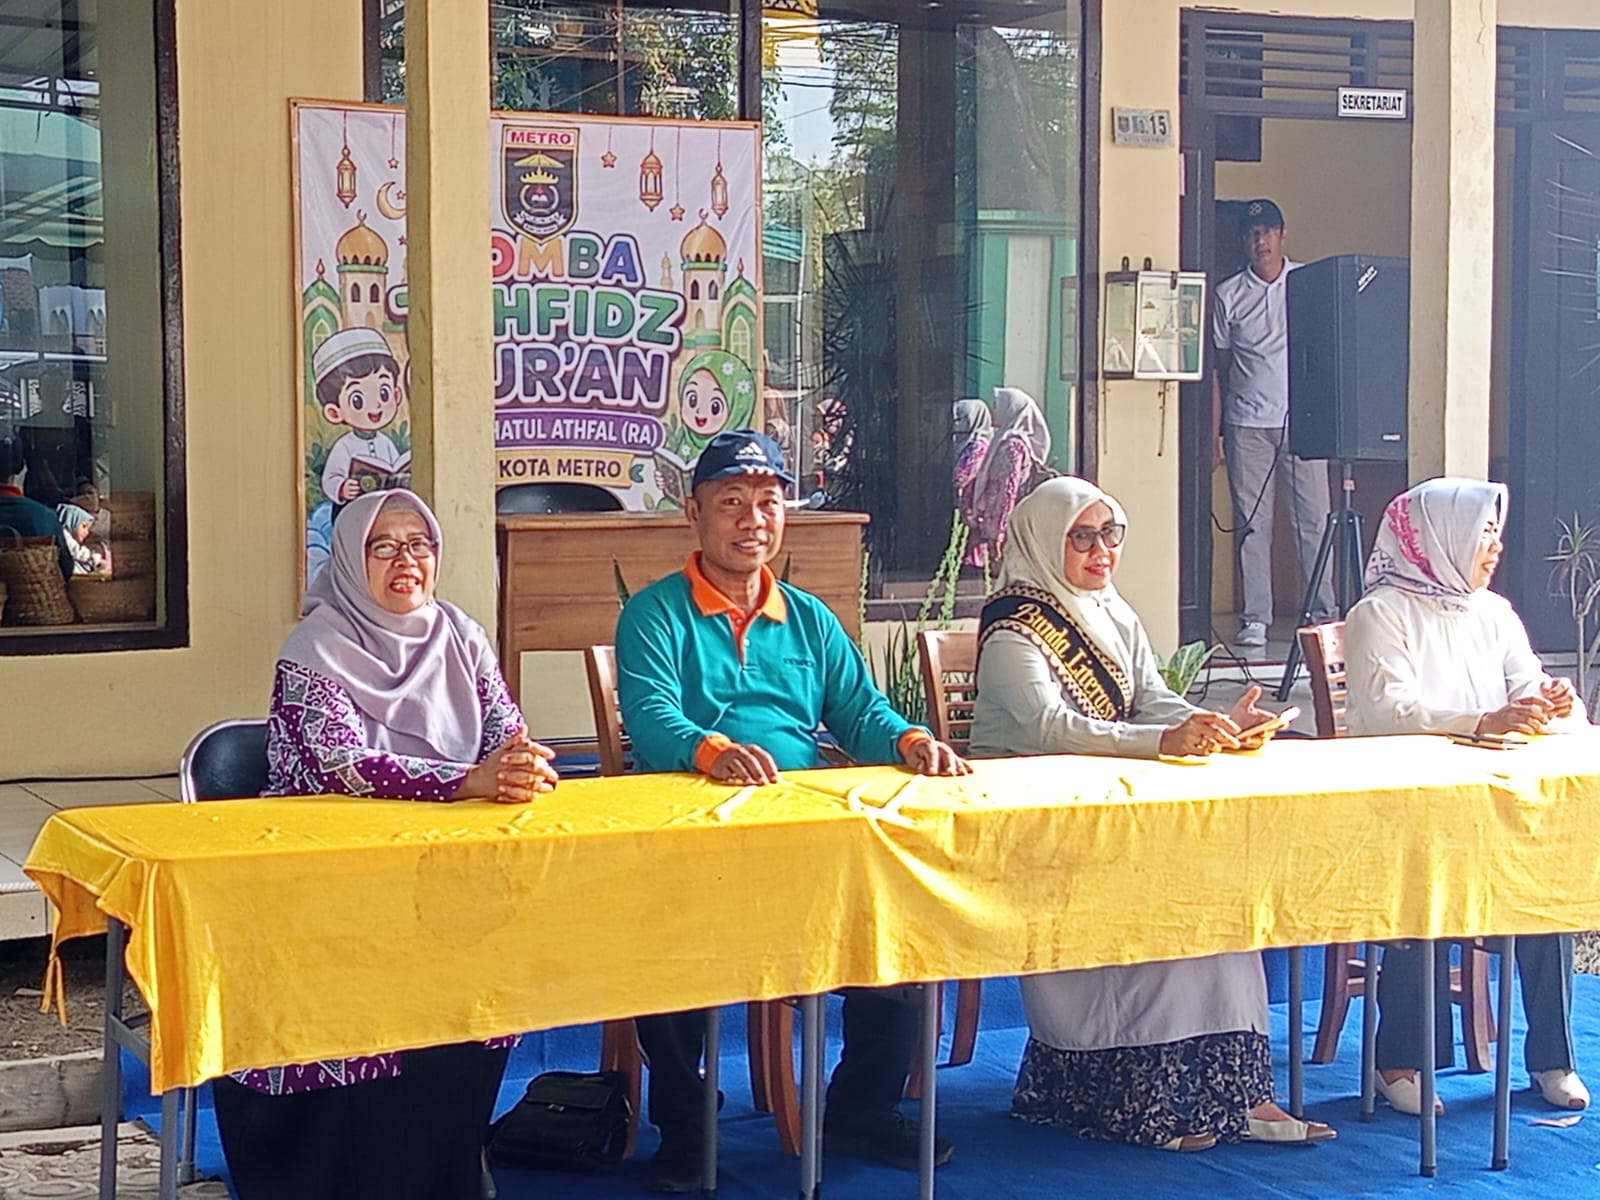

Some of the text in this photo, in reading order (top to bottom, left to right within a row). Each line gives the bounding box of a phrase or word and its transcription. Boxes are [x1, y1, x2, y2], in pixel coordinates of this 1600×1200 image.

[1343, 94, 1402, 111] SEKRETARIAT
[511, 131, 571, 144] METRO
[492, 236, 638, 282] OMBA
[395, 287, 680, 346] HFIDZ
[494, 346, 664, 402] UR'AN
[551, 418, 617, 442] ATHFAL
[621, 421, 658, 446] (RA)
[499, 459, 621, 478] KOTA METRO
[1010, 603, 1071, 658] Bunda
